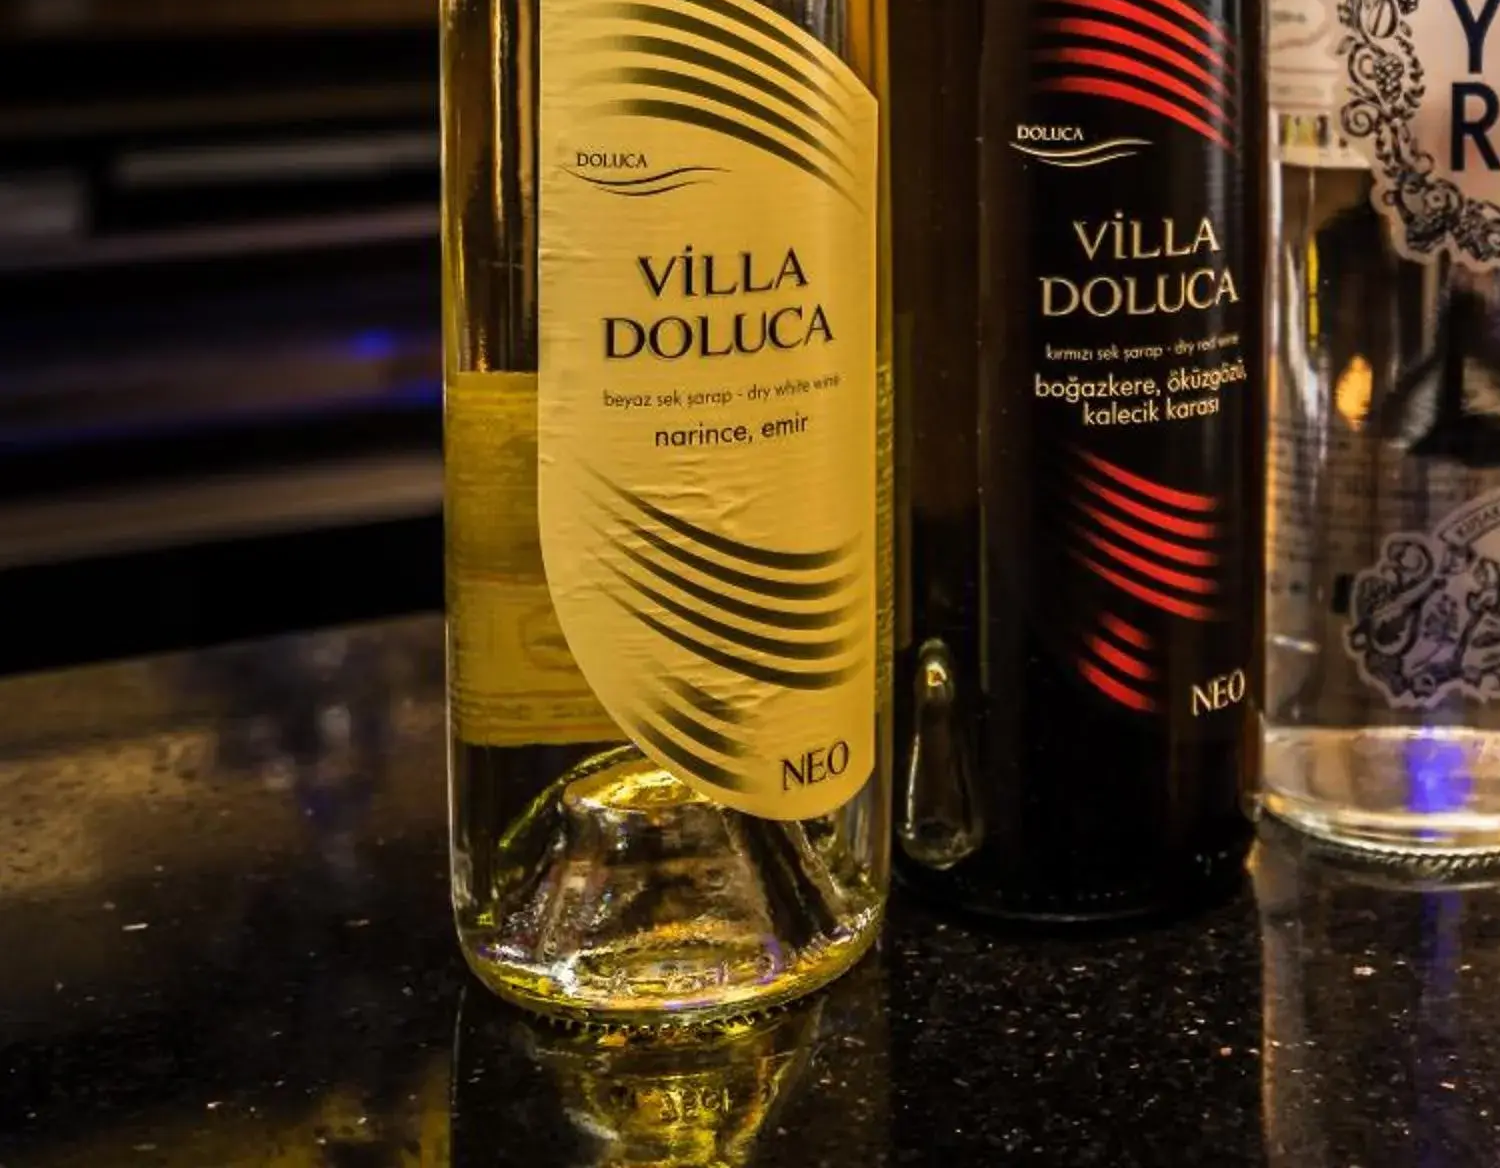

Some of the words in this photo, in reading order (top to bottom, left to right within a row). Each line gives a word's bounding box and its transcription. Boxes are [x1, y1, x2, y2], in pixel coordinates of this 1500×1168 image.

[1016, 124, 1085, 141] DOLUCA
[576, 151, 648, 168] DOLUCA
[1073, 210, 1221, 261] VİLLA
[638, 243, 810, 298] VİLLA
[1037, 267, 1240, 317] DOLUCA
[602, 303, 835, 360] DOLUCA
[1097, 343, 1119, 360] sek
[1174, 337, 1195, 356] dry
[602, 389, 652, 408] beyaz
[657, 388, 682, 406] sek
[747, 383, 771, 402] dry
[1034, 371, 1161, 403] boğazkere,
[655, 422, 753, 447] narince,
[761, 411, 809, 438] emir
[1082, 399, 1160, 426] kalecik
[1191, 668, 1246, 717] NEO
[780, 739, 849, 791] NEO
